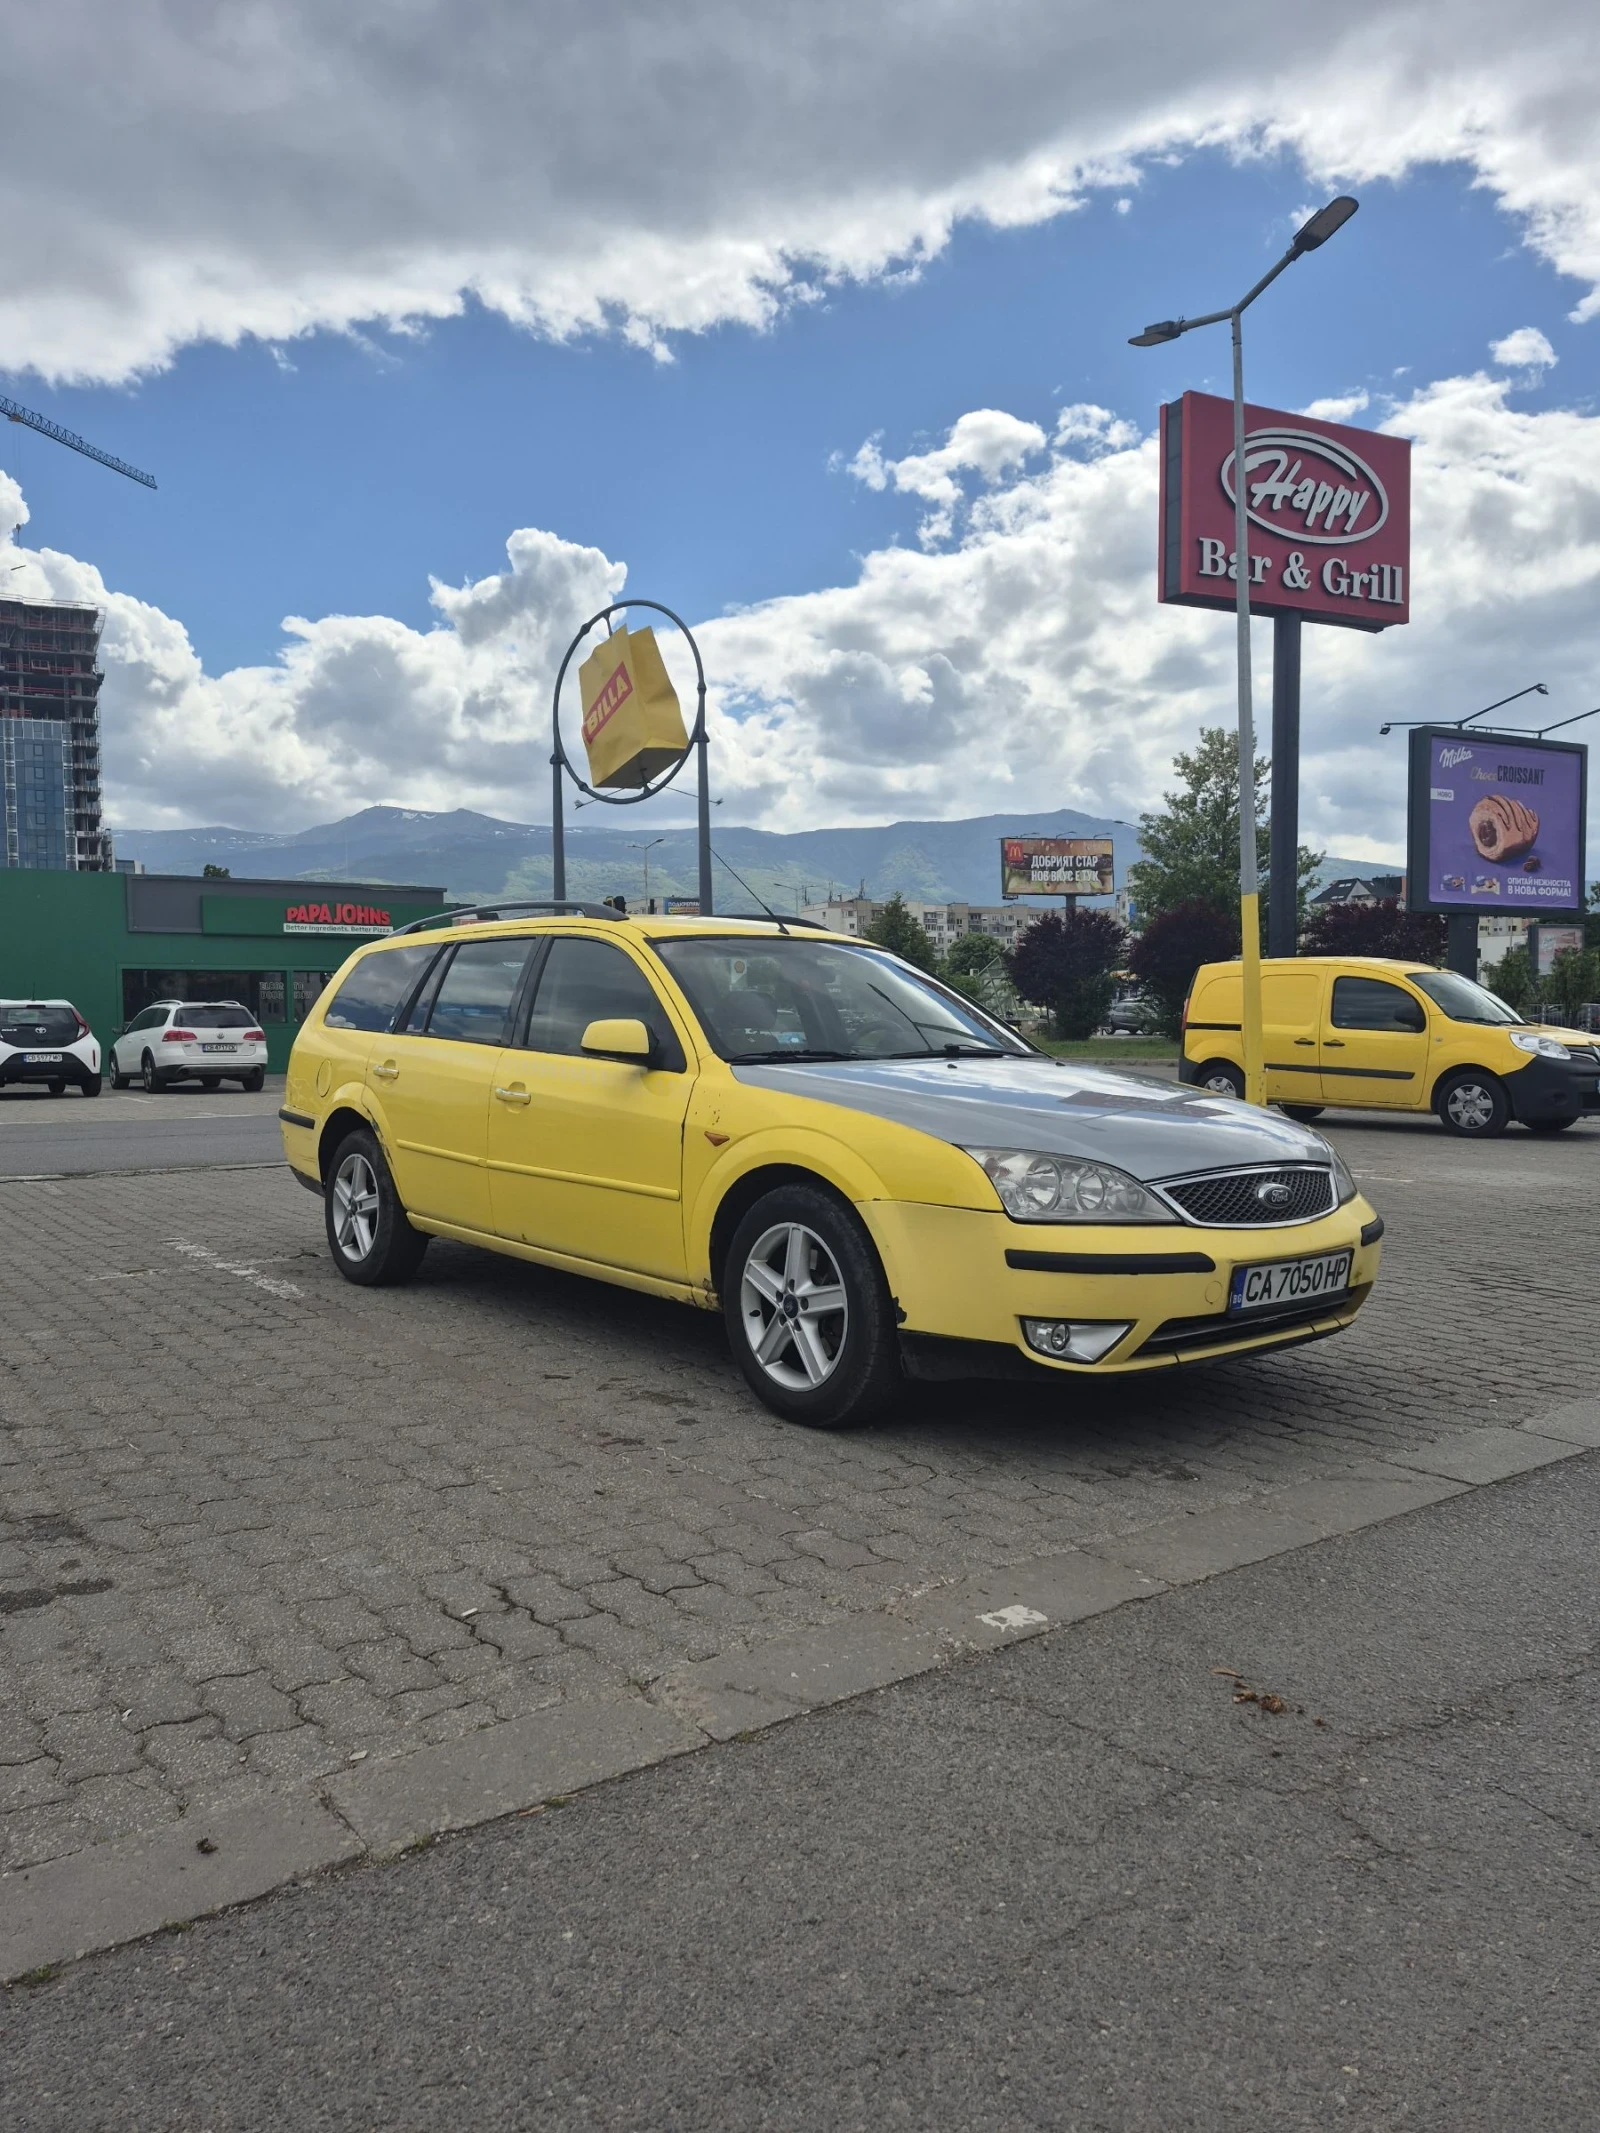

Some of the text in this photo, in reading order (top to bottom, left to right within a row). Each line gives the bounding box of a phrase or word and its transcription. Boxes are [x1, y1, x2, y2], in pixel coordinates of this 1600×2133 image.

[1245, 449, 1370, 533] Happy
[1283, 551, 1312, 589] &
[1322, 558, 1404, 604] Grill
[585, 676, 629, 734] BILLA
[1439, 746, 1473, 768] Milka
[1497, 765, 1545, 785] CROISSANT
[1031, 855, 1099, 869] ДОБРИЯТ СТАР
[1031, 870, 1099, 882] НОВ ВКУС Е ТУК
[1507, 876, 1571, 887] ОПИТАЙ НЕЖНОСТТА
[1507, 885, 1571, 897] В НОВА ФОРМА!
[286, 902, 391, 925] PAPA JOHNS
[1271, 1189, 1289, 1203] Ford
[1232, 1293, 1242, 1304] BG
